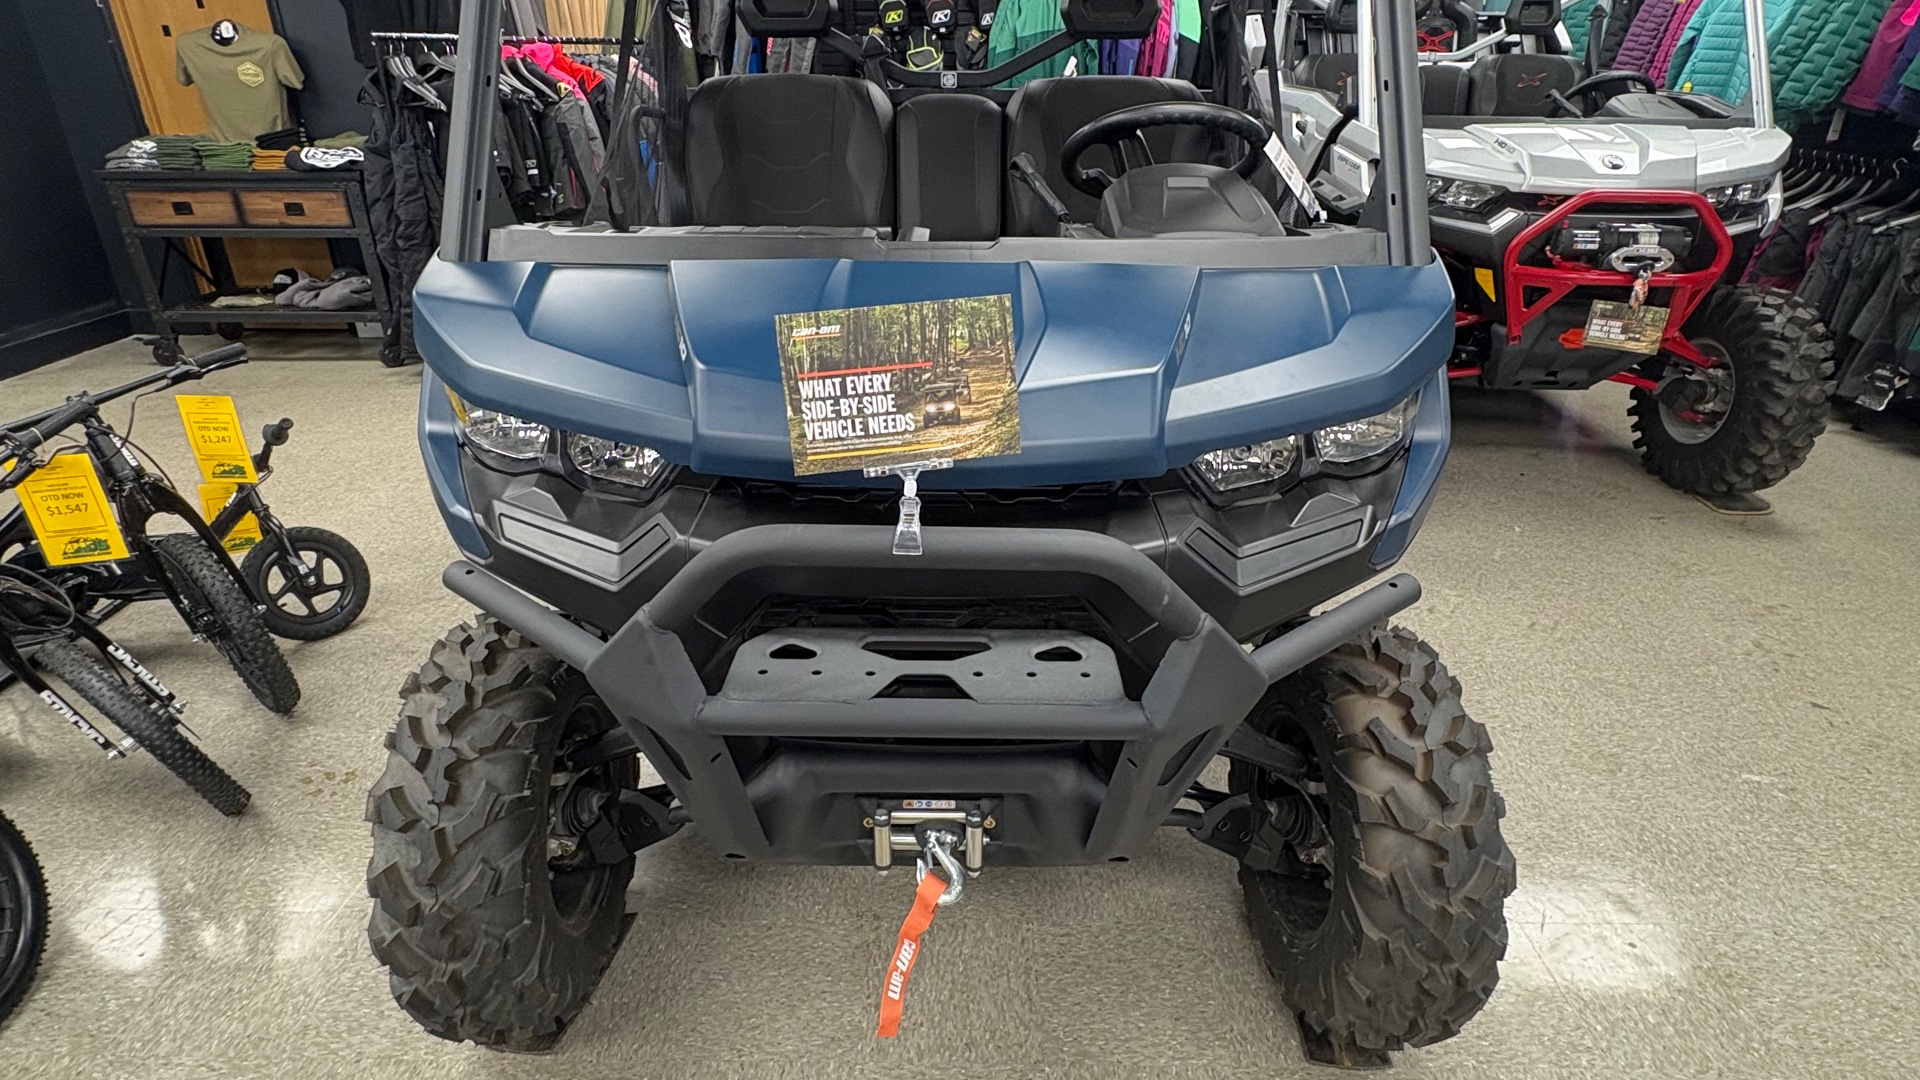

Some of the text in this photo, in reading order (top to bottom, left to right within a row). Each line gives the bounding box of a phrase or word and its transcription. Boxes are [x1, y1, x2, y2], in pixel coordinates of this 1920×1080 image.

[1493, 138, 1516, 154] HD10
[798, 373, 892, 399] WHAT EVERY
[801, 394, 897, 421] SIDE-BY-SIDE
[803, 413, 916, 441] VEHICLE NEEDS
[201, 434, 231, 444] $1,247
[40, 492, 84, 502] OTD NOW
[46, 503, 89, 517] $1,547
[887, 938, 916, 1001] can-am
